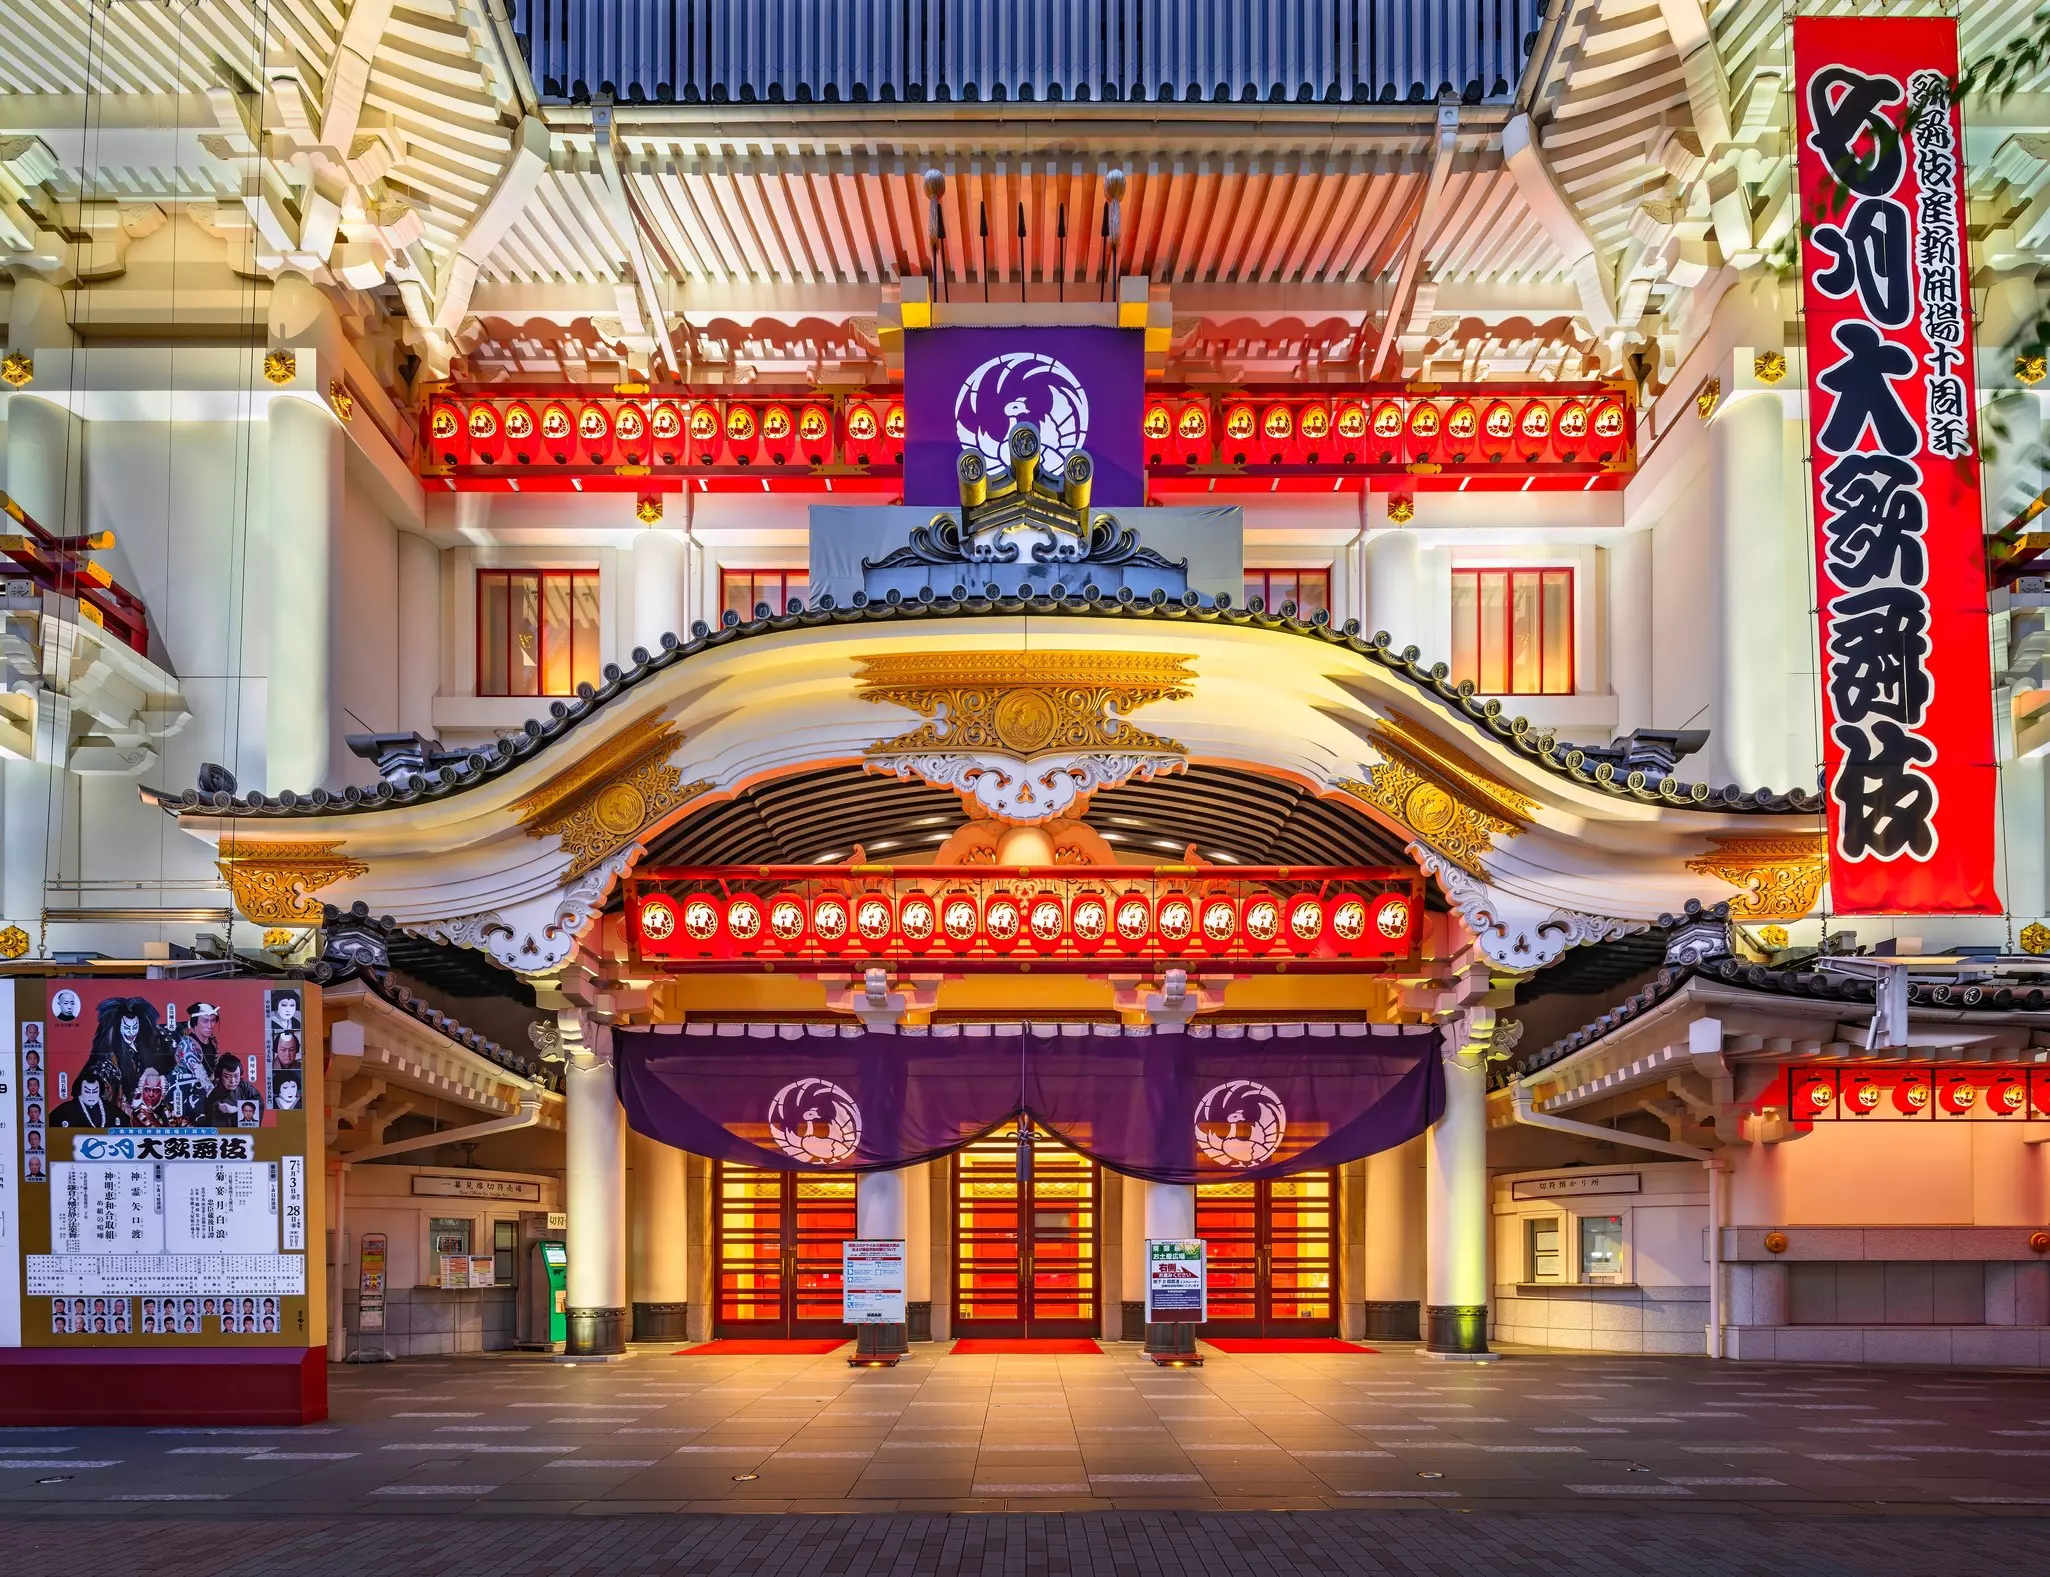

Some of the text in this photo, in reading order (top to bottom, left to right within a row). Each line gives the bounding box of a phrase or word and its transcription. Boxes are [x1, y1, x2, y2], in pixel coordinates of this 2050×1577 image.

[80, 1137, 248, 1160] 七月大歌舞伎
[441, 1180, 522, 1192] 一幕見席切符売場
[1539, 1178, 1600, 1190] 切符預かり所
[549, 1215, 567, 1226] 切符
